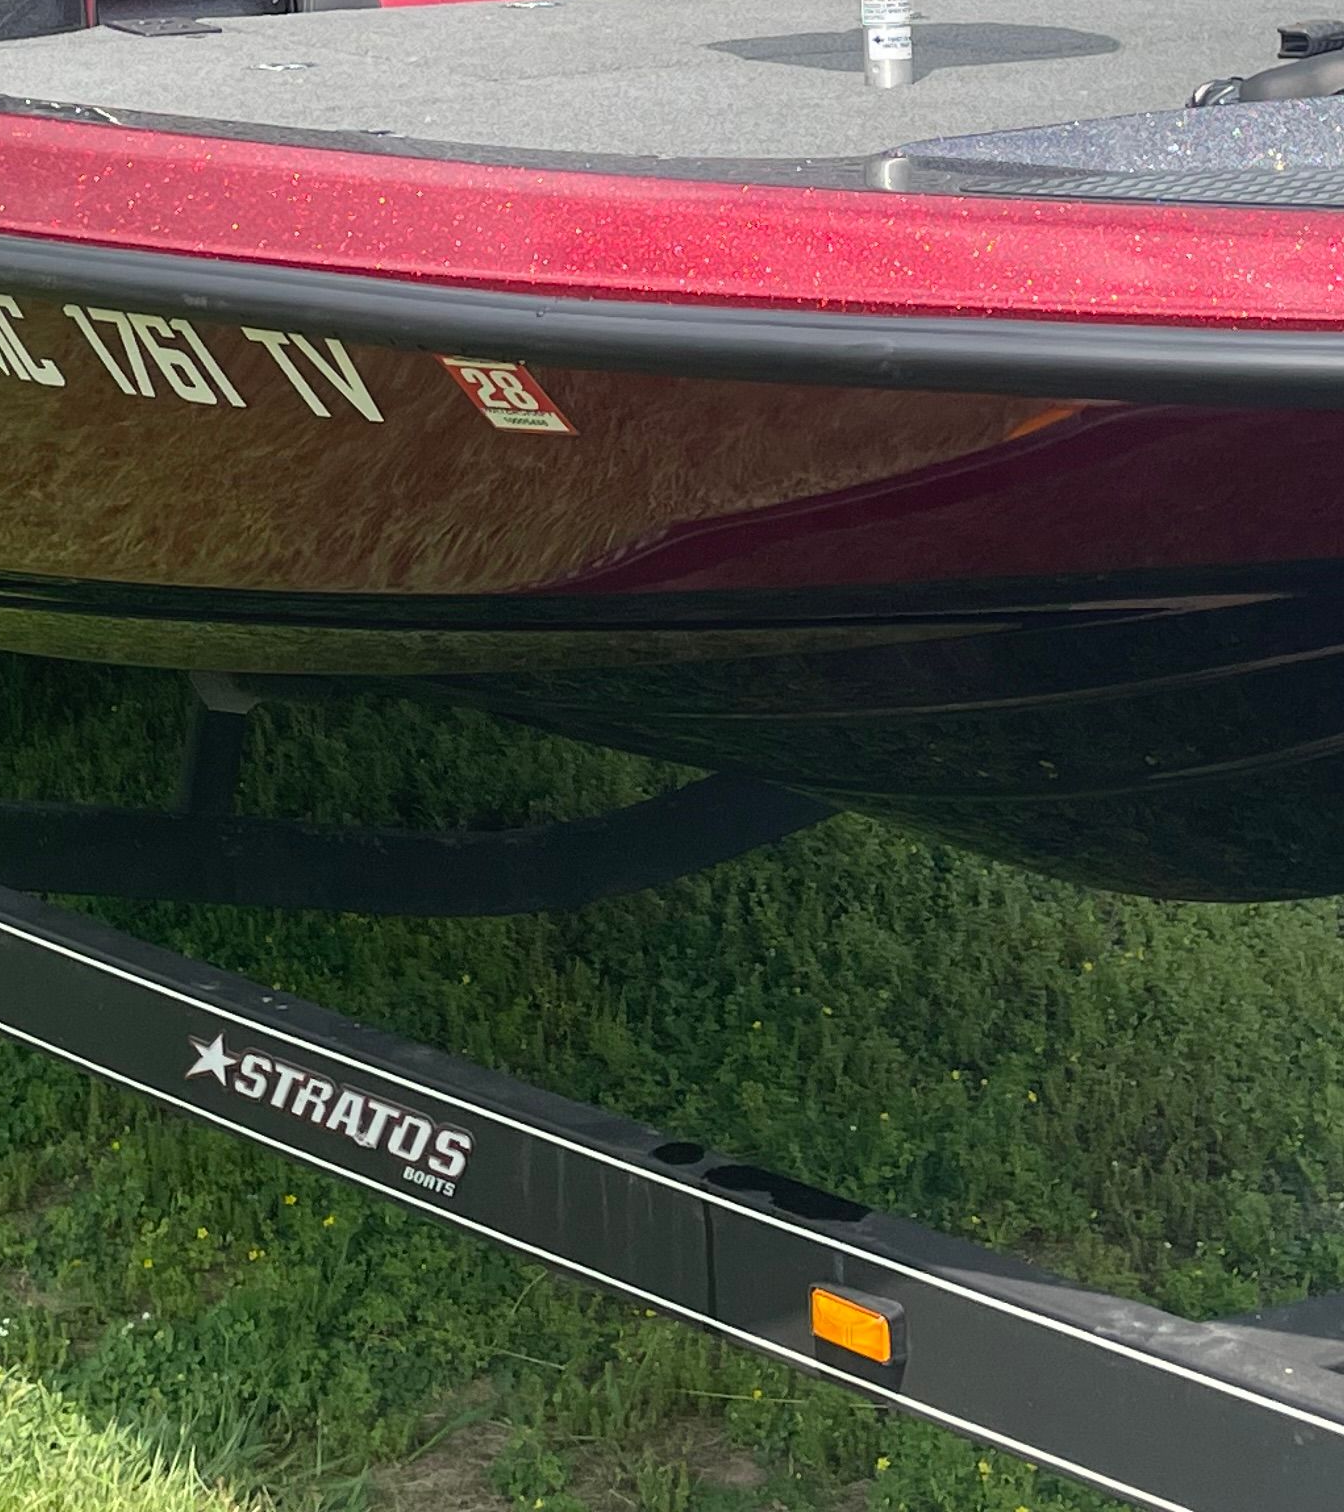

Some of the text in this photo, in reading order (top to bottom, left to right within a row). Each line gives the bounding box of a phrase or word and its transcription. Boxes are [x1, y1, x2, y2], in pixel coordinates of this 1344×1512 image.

[63, 304, 247, 407] 1761
[241, 326, 385, 423] TV
[460, 367, 539, 410] 28
[234, 1052, 474, 1178] STRATOS
[403, 1166, 456, 1197] BOATS
